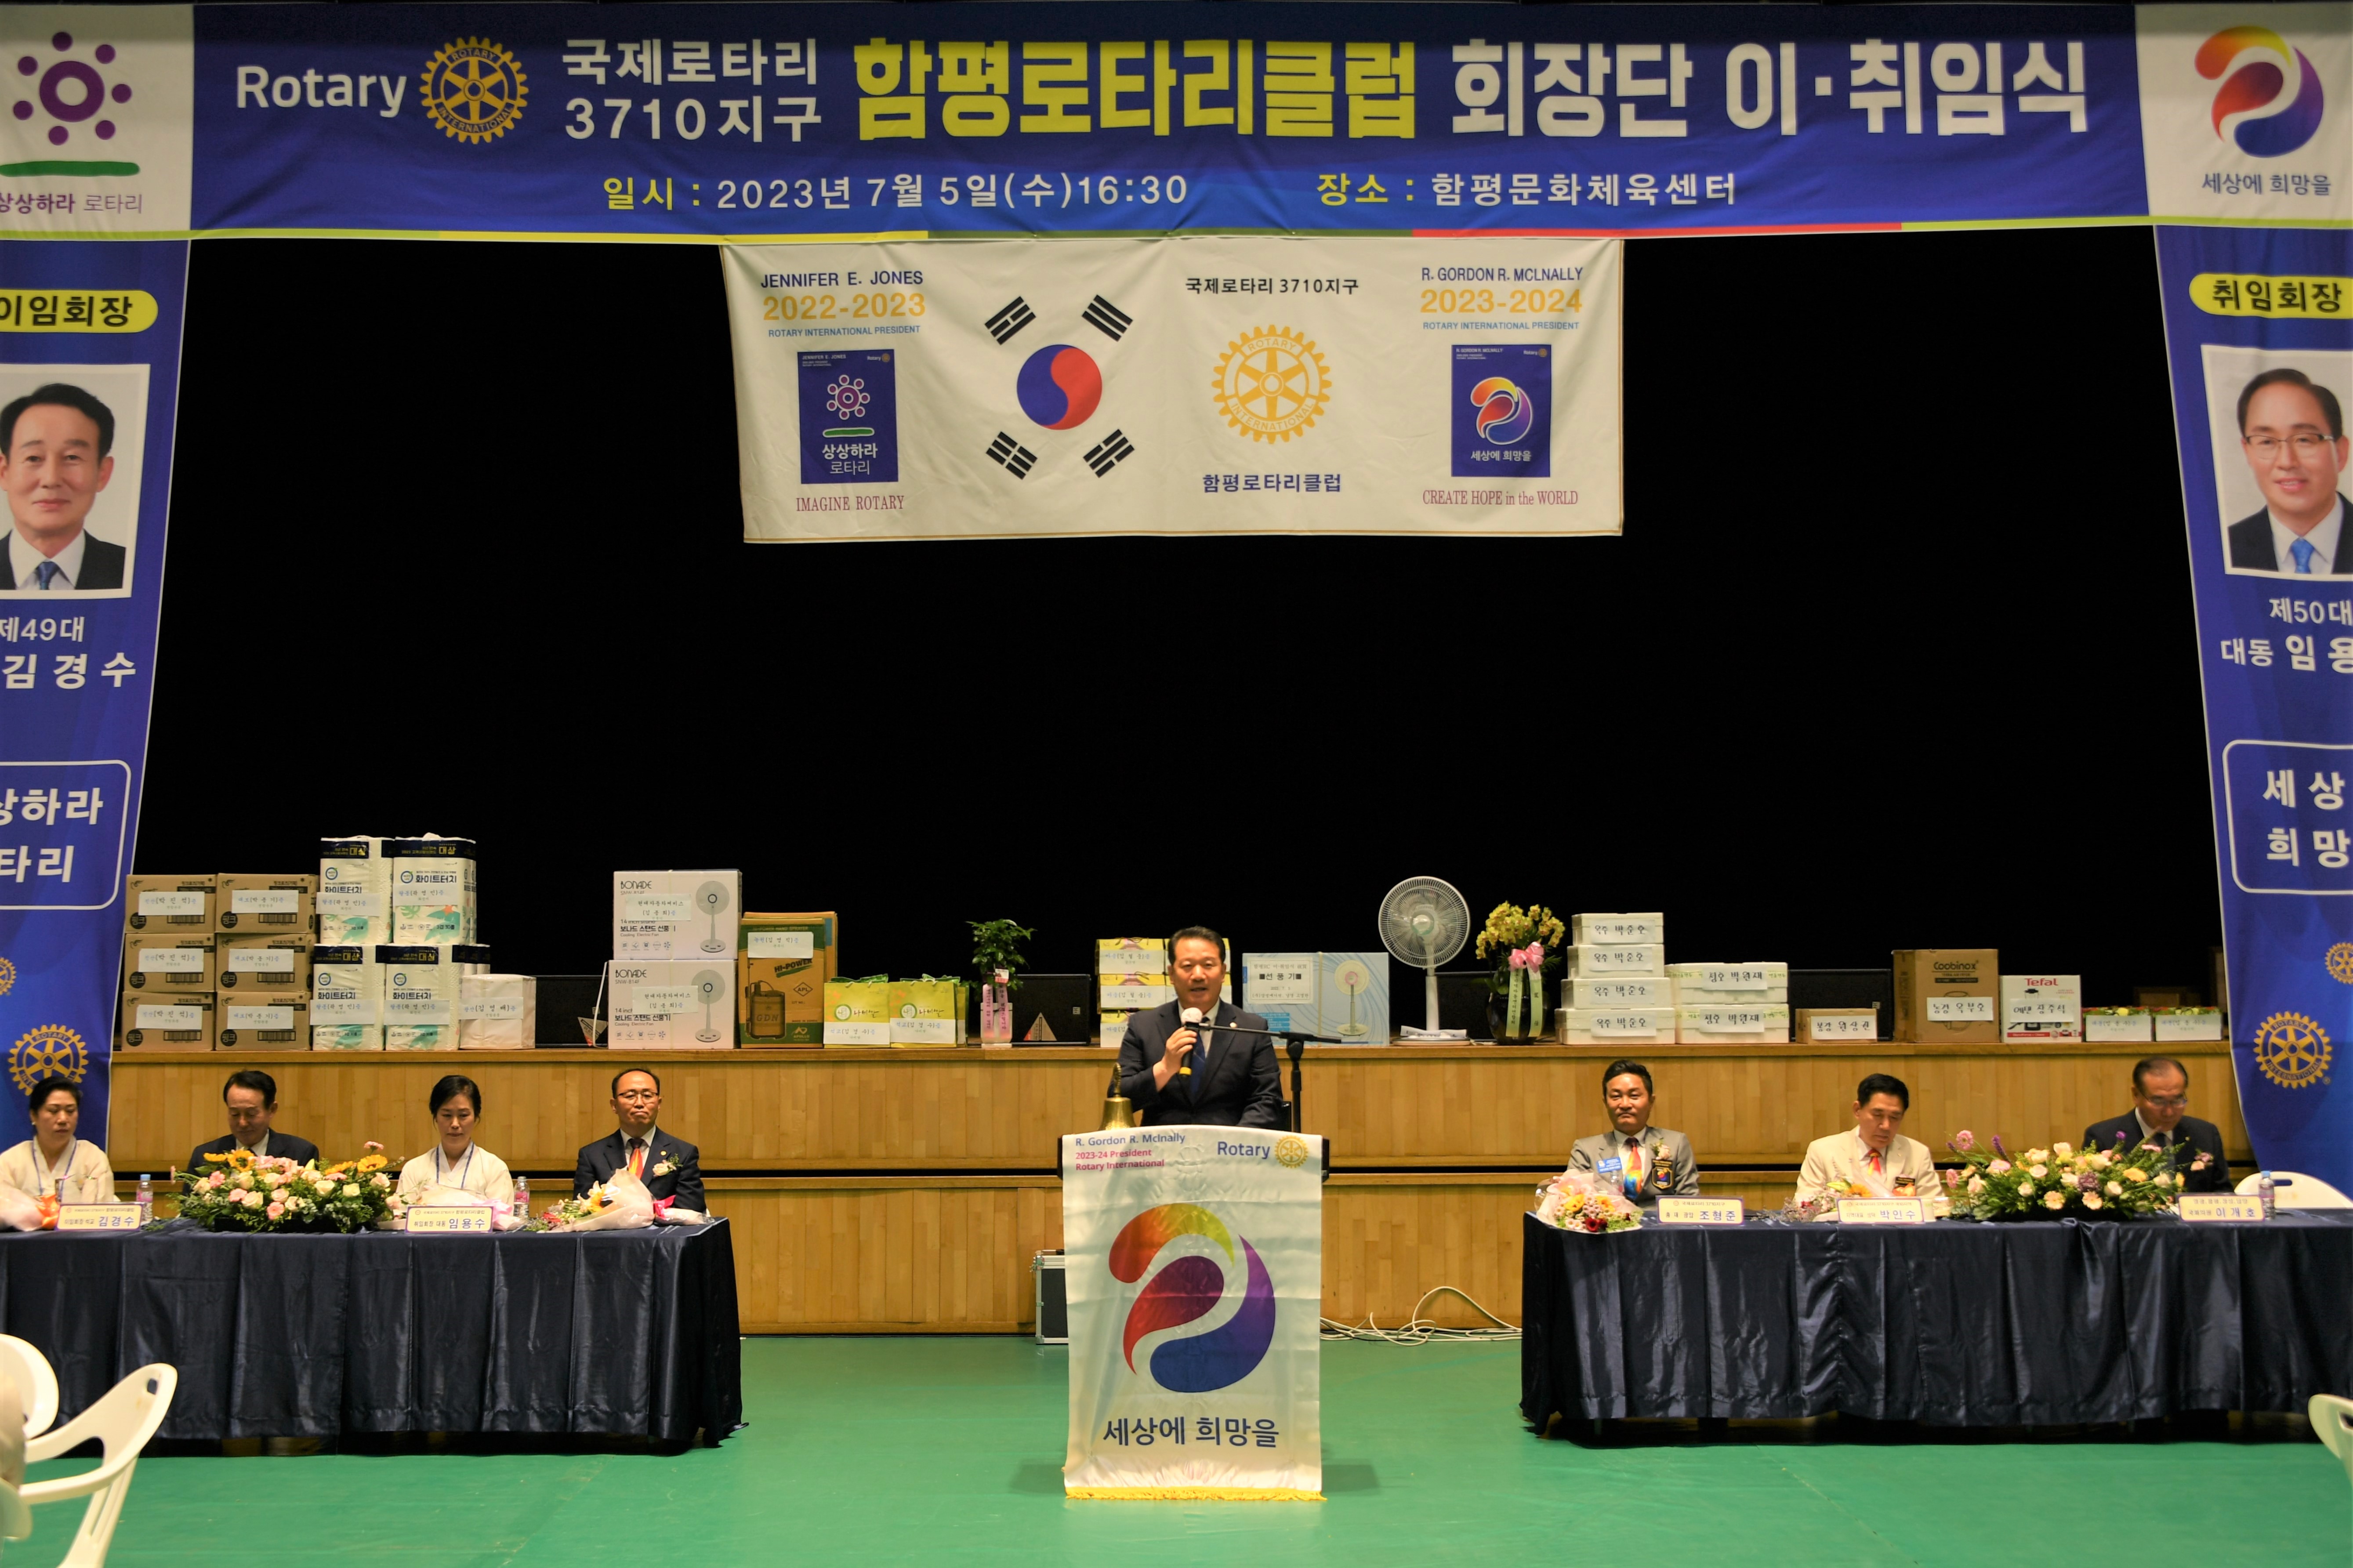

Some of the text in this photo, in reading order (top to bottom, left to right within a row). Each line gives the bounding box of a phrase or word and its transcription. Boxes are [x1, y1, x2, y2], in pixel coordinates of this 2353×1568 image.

[450, 47, 497, 62] ROTARY
[563, 39, 817, 85] 국제로타리
[236, 65, 407, 117] Rotary
[854, 37, 1415, 141] 함평로타리클럽
[1452, 39, 1692, 138] 회장단
[439, 106, 512, 134] INTERNATIONAL
[566, 97, 822, 142] 3710지구
[603, 177, 674, 210] 일시
[718, 177, 850, 210] 2023년
[867, 174, 922, 206] 7월
[1316, 173, 1388, 206] 장소
[1432, 173, 1735, 207] 함평문화체육센터
[2202, 173, 2332, 196] 세상에 희망을
[83, 193, 143, 214] 로타리
[761, 270, 924, 289] JENNIFER E. JONES
[1421, 267, 1584, 282] R. GORDON R. MCLNALLY
[1185, 277, 1360, 295] 국제로타리 3710지구
[1420, 289, 1583, 314] 2023-2024
[2212, 279, 2342, 313] 취임회장
[763, 292, 926, 322] 2022-2023
[768, 325, 921, 338] ROTARY INTERNATIONAL PRESIDENT
[1423, 321, 1580, 330] ROTARY INTERNATIONAL PRESIDENT
[1247, 338, 1297, 352] ROTARY
[1231, 401, 1314, 431] INTERNATIONAL
[822, 443, 878, 460] 상상하라
[1471, 450, 1532, 462] 세상에 희망을
[830, 460, 870, 476] 로타리
[1202, 474, 1341, 493] 함평로타리클럽
[796, 495, 905, 512] IMAGINE ROTARY
[1423, 490, 1578, 505] CREATE HOPE in the WORLD
[2270, 598, 2353, 626] 제50대
[0, 616, 85, 643] 제49대
[2221, 637, 2273, 667] 대동
[439, 847, 456, 855] 대상
[620, 880, 653, 889] BONADE
[343, 952, 360, 961] 대상
[419, 952, 435, 961] 대상
[615, 969, 647, 978] BONADE
[774, 958, 813, 973] HI-POWER
[1933, 961, 1976, 970] Coobinox
[2025, 978, 2059, 986] Tefal
[2273, 1019, 2306, 1030] ROTARY
[35, 1032, 69, 1042] ROTARY
[2266, 1058, 2323, 1081] INTERNATIONAL
[1075, 1133, 1186, 1147] R. Gordon R. McInally
[1076, 1148, 1152, 1160] 2023-24 President
[1217, 1141, 1271, 1159] Rotary
[1076, 1159, 1165, 1172] Rotary International
[1103, 1416, 1280, 1448] 세상에 희망을
